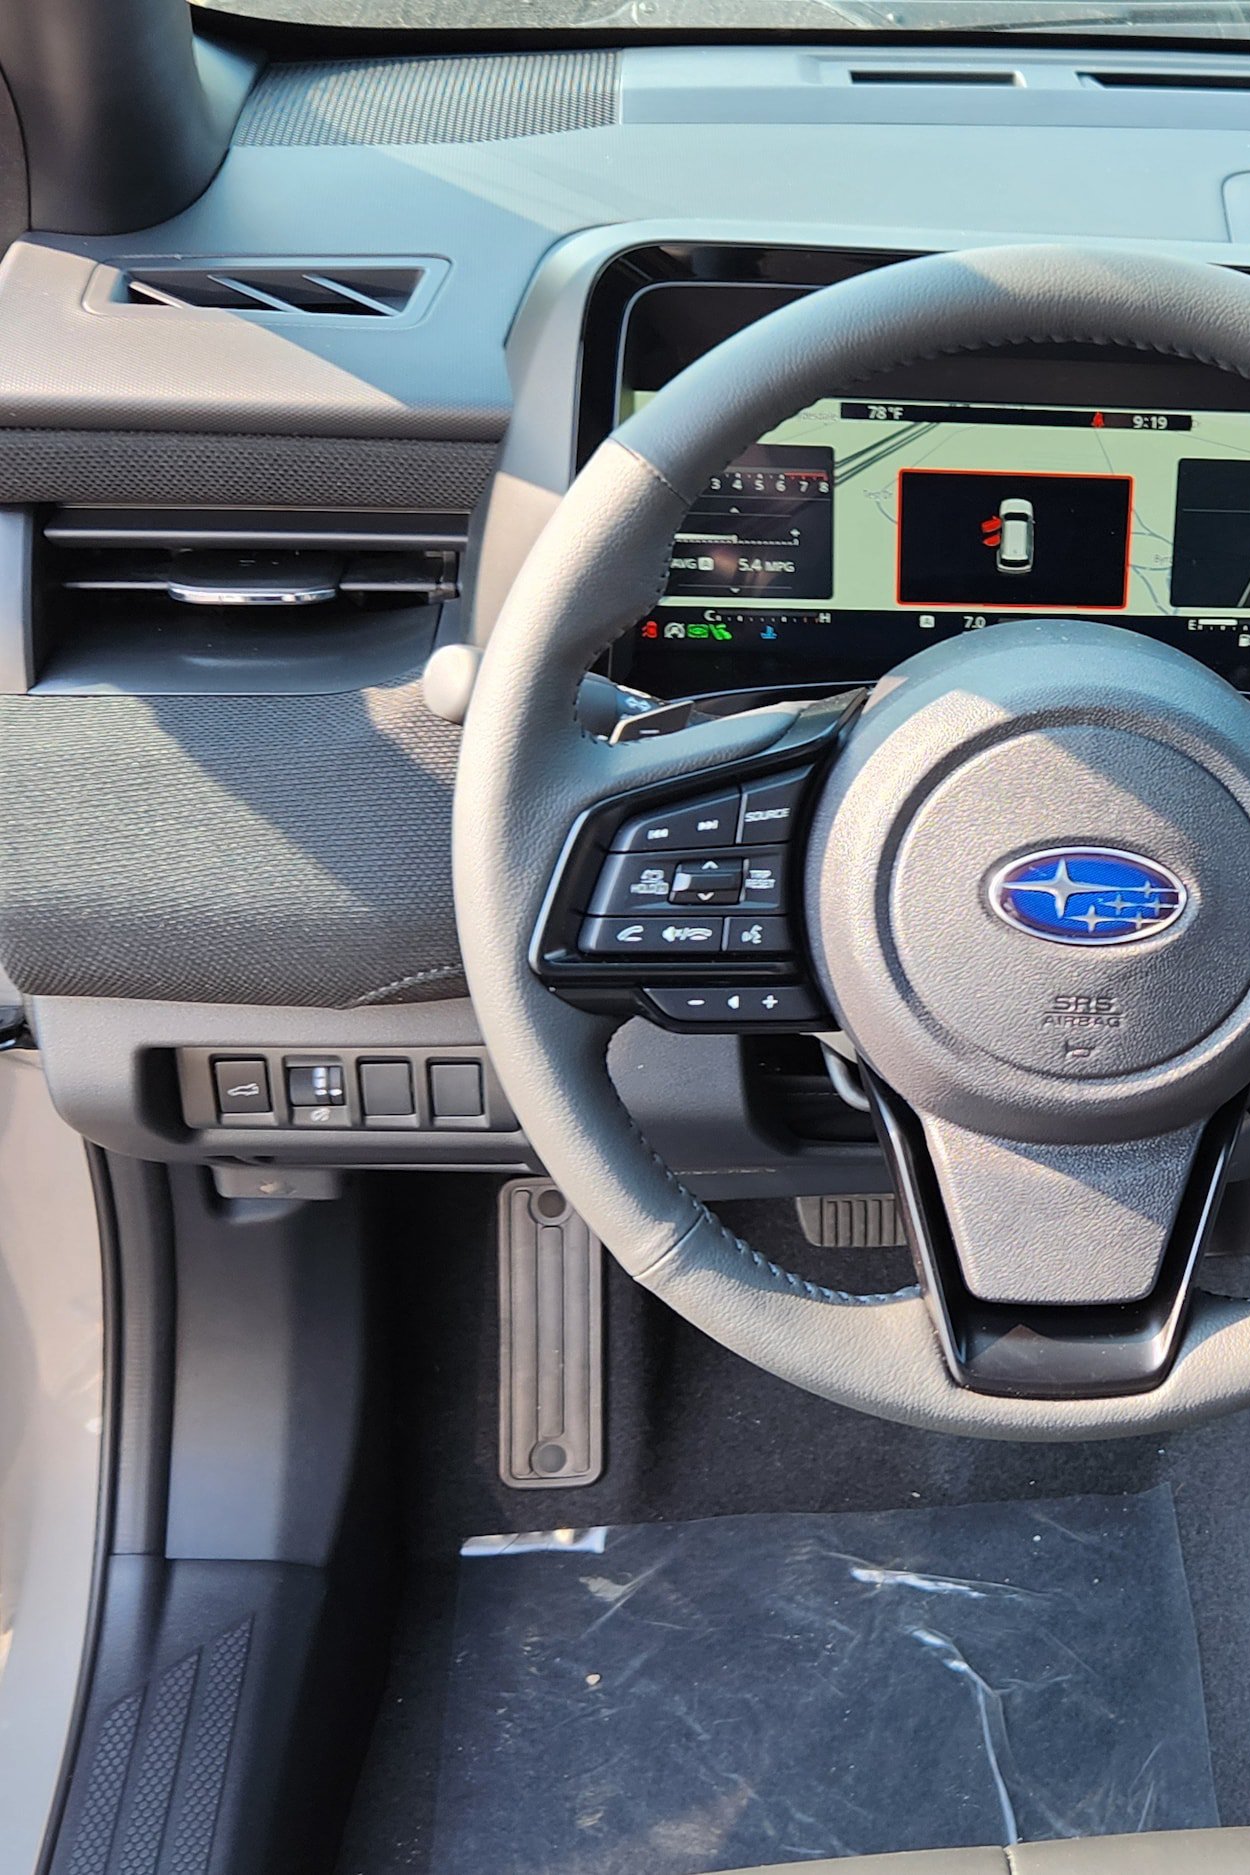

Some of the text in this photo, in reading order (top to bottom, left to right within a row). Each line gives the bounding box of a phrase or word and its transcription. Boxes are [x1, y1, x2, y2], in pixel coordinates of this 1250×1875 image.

[867, 405, 904, 420] 78°F
[1133, 415, 1168, 429] 9:19
[711, 478, 721, 490] 3
[732, 478, 743, 490] 4
[755, 479, 764, 491] 5
[776, 480, 786, 492] 6
[799, 481, 809, 492] 7
[819, 613, 831, 623] H
[1188, 619, 1196, 631] E
[745, 807, 790, 822] SOURCE
[1054, 996, 1114, 1010] SRS
[1044, 1016, 1121, 1027] AIRBAG
